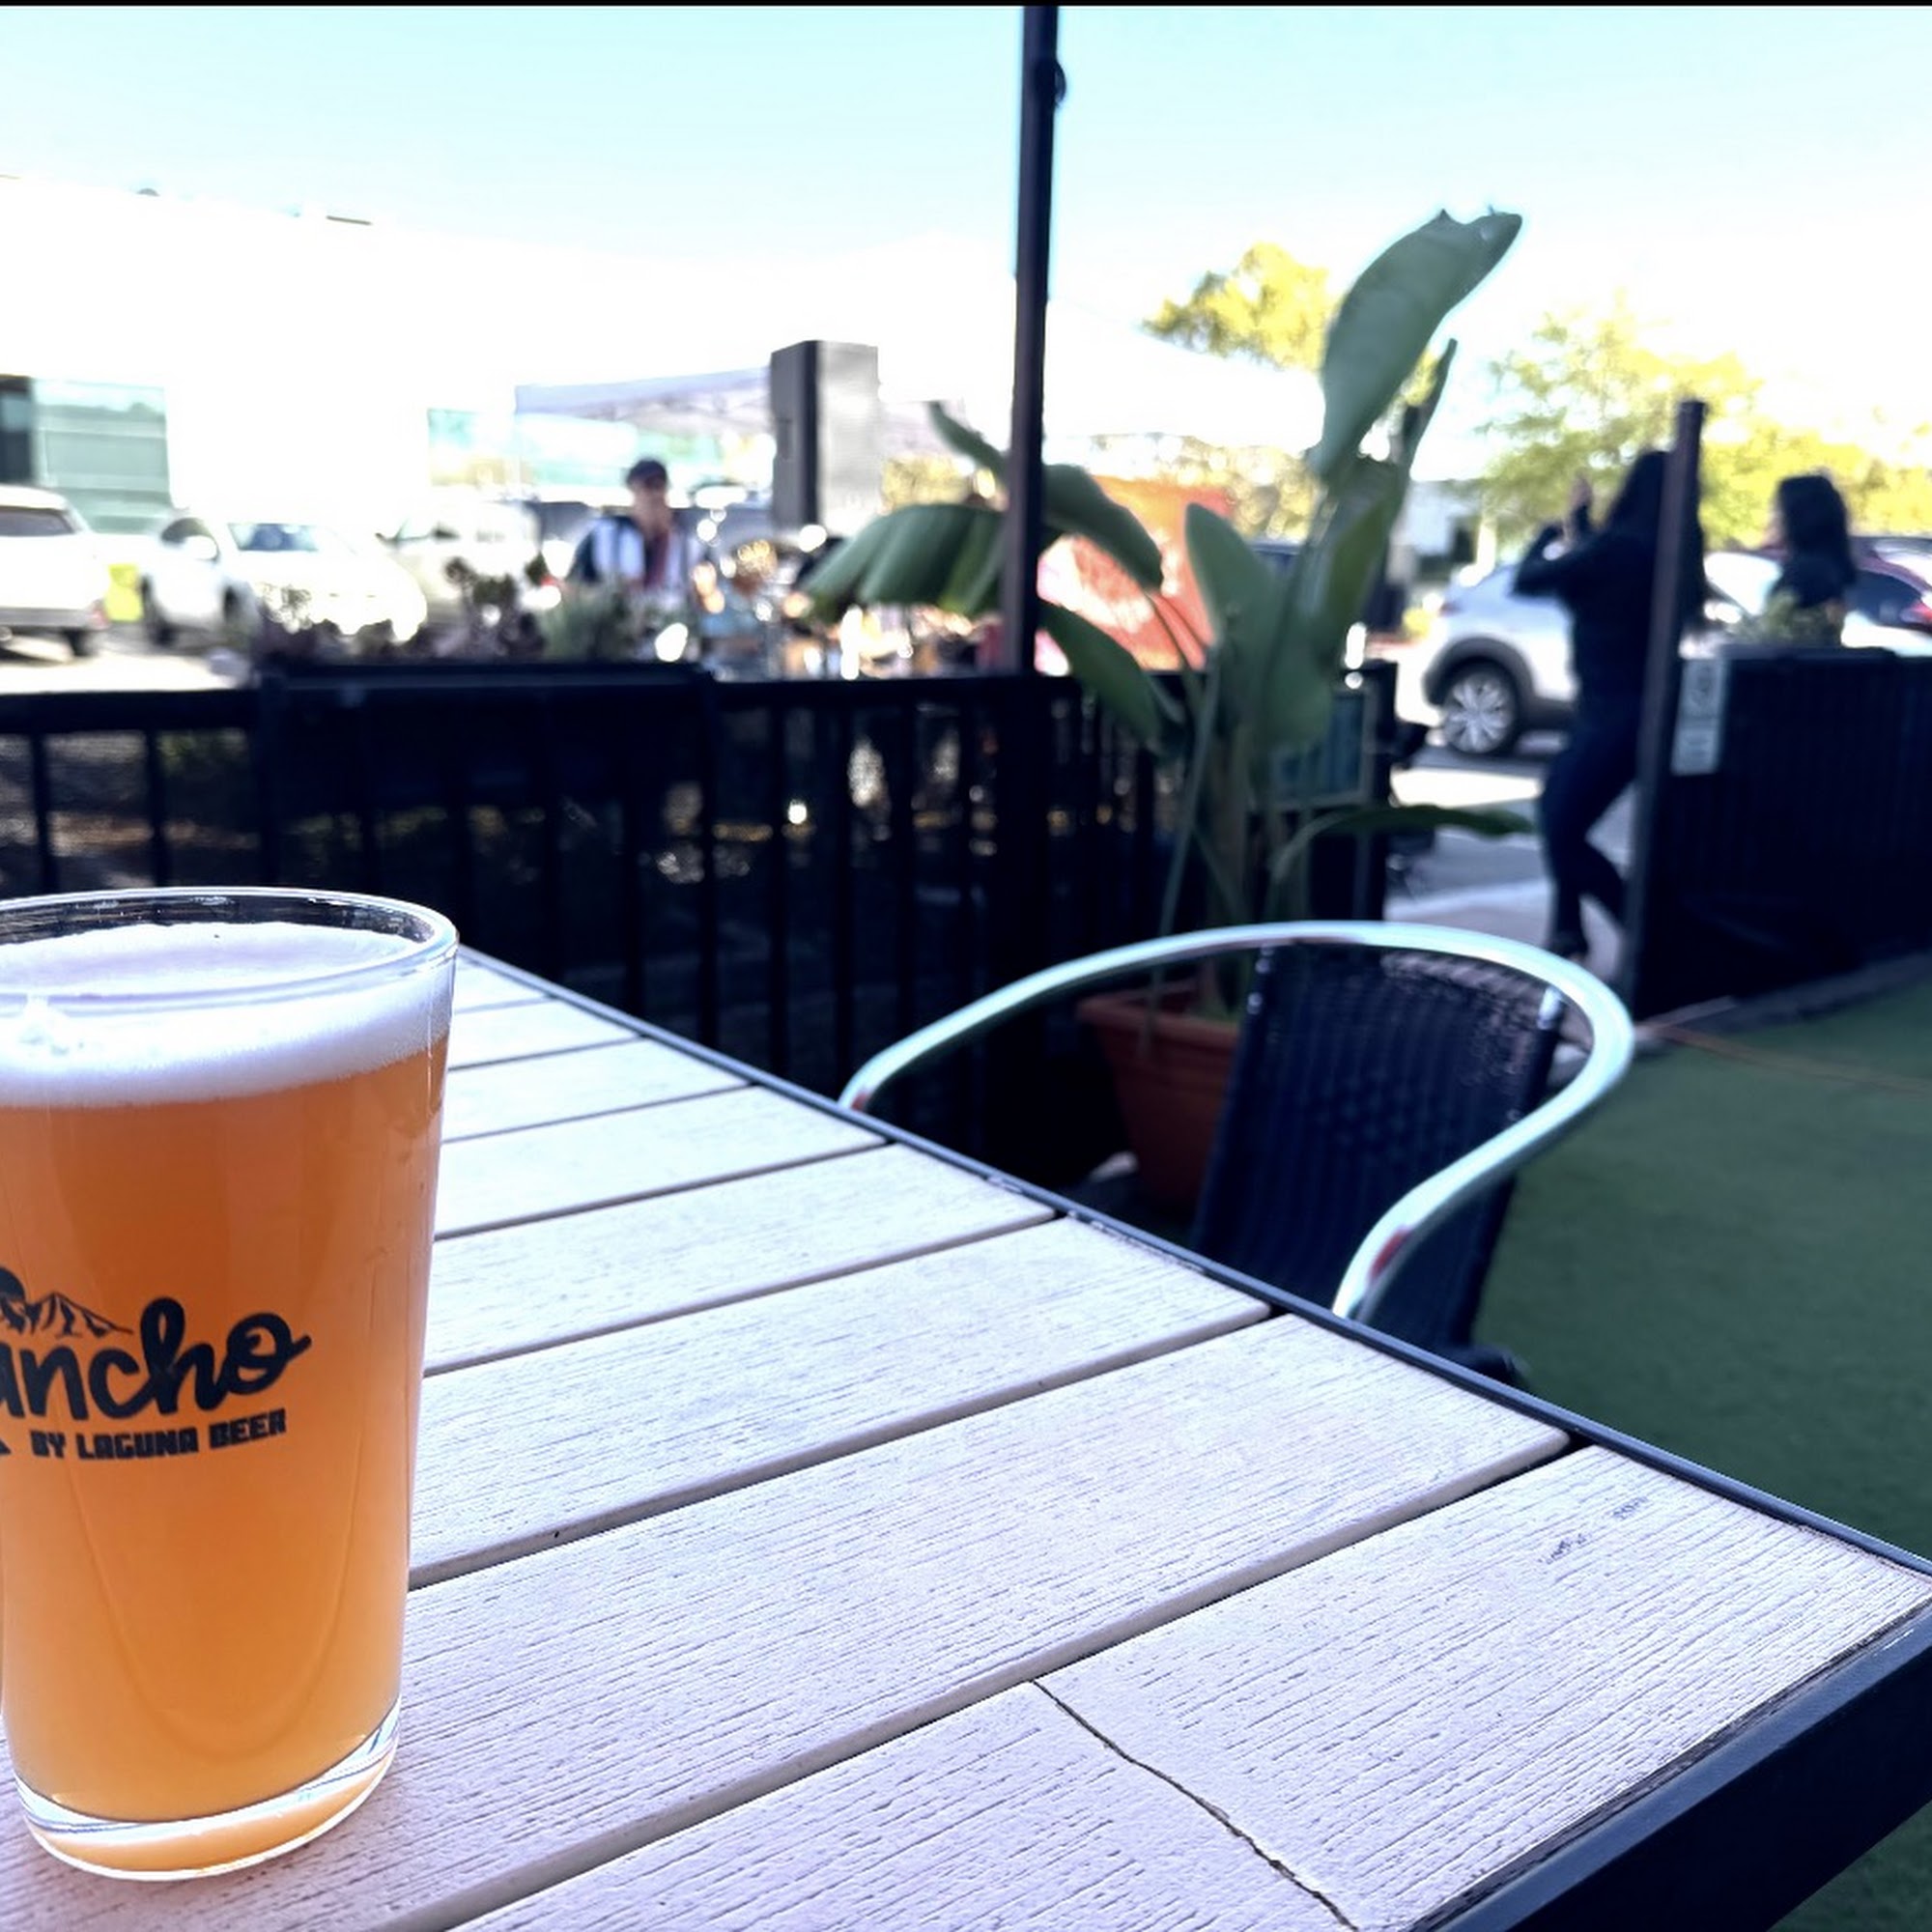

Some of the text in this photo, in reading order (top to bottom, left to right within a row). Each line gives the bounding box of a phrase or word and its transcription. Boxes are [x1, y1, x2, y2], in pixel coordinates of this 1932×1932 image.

[0, 1267, 312, 1455] ncho
[30, 1407, 286, 1460] BY LAGUNA BEER
